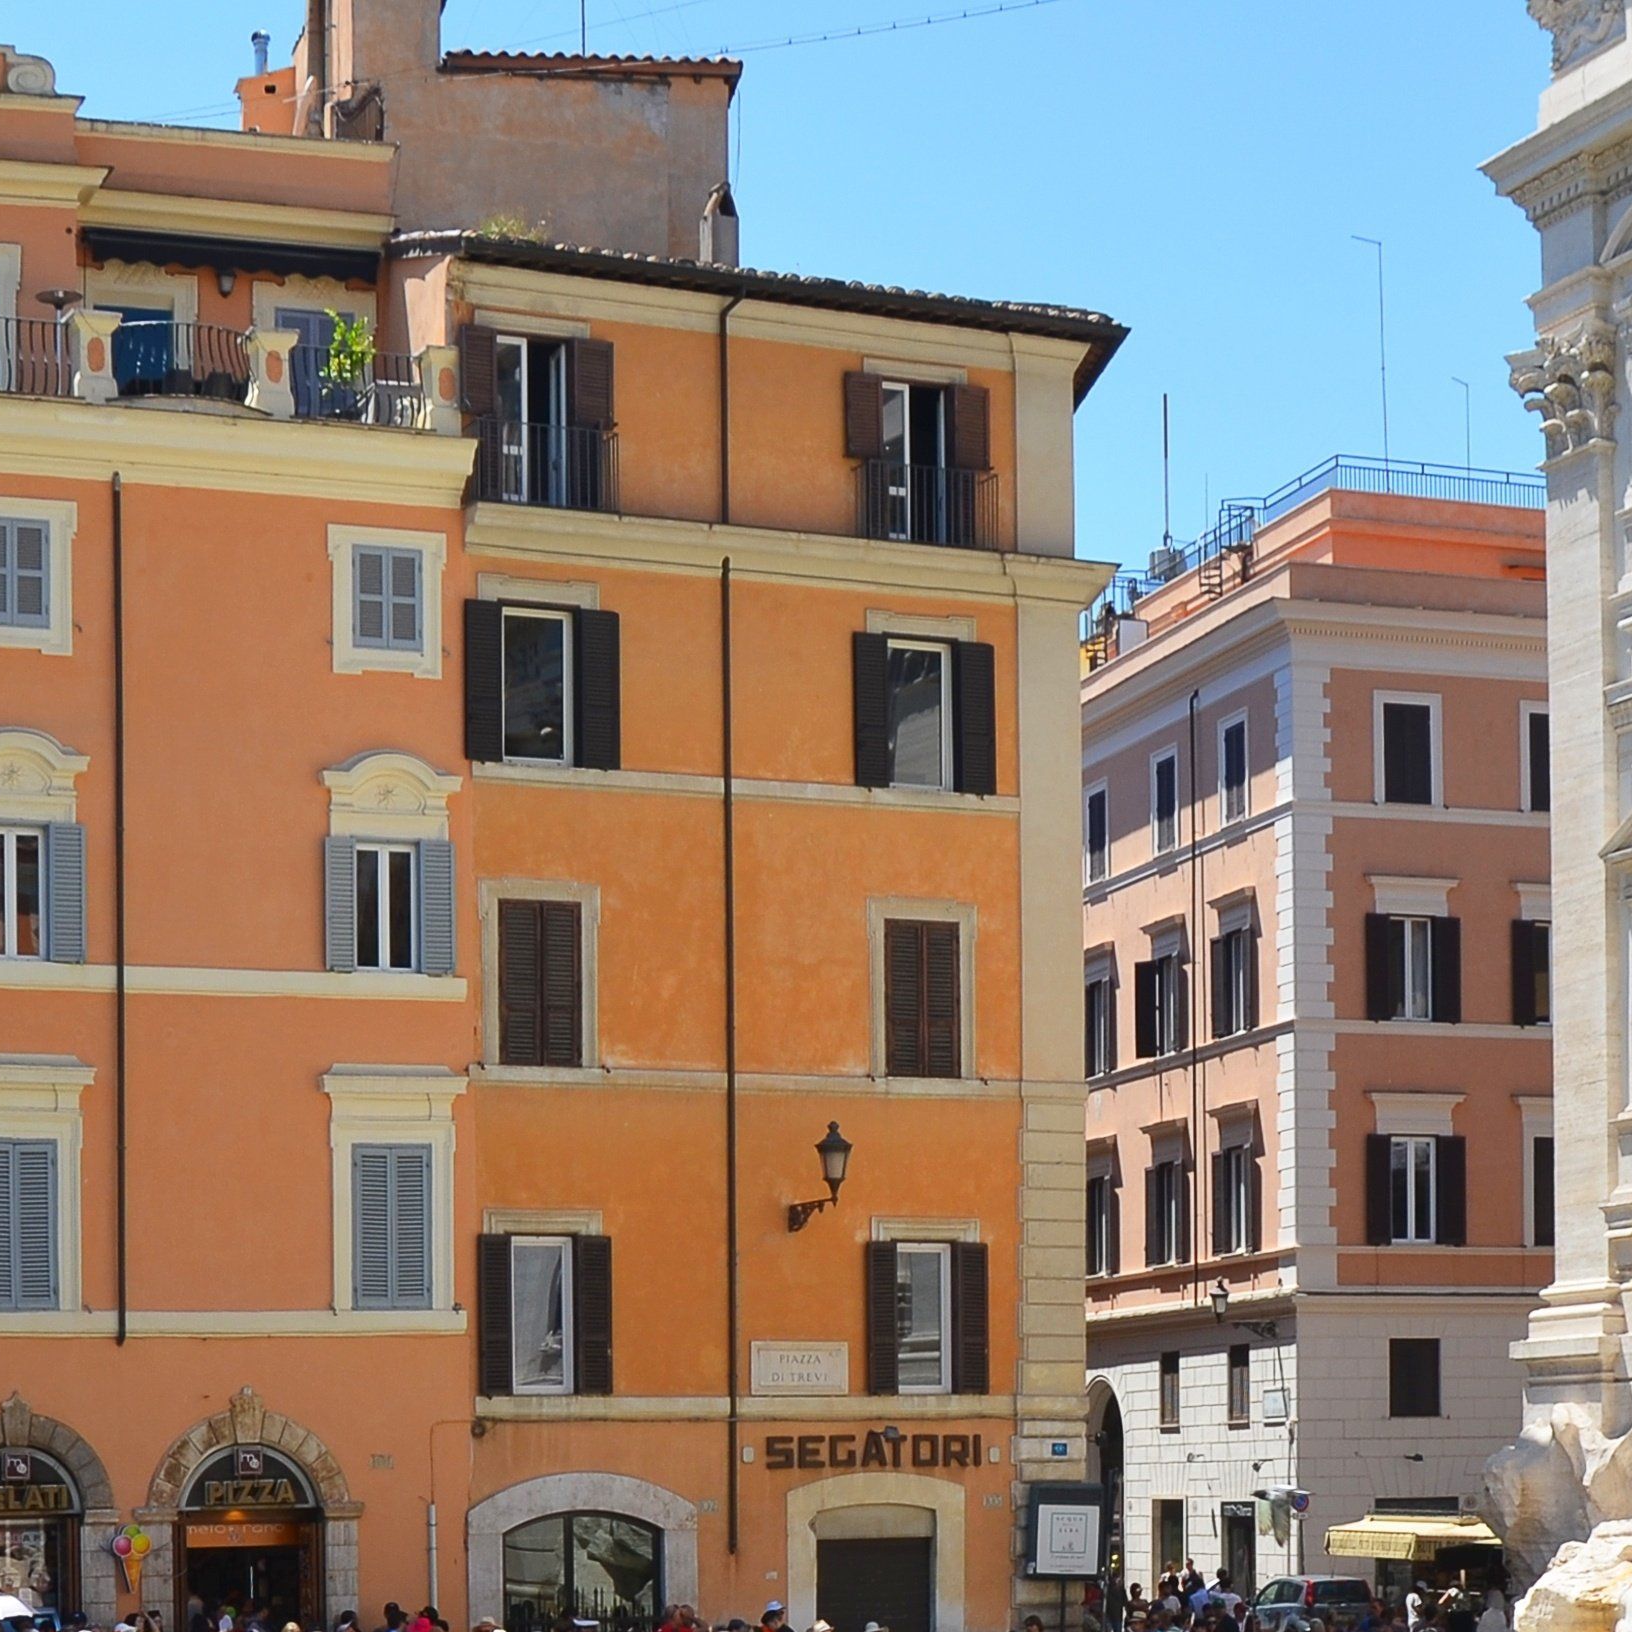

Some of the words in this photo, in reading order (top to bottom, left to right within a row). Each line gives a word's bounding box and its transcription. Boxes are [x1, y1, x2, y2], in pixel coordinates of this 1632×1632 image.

[779, 1354, 822, 1364] PIAZZA
[771, 1372, 784, 1382] DI
[790, 1372, 828, 1382] TREVI
[765, 1433, 982, 1470] SEGATORI
[204, 1478, 297, 1505] PIZZA
